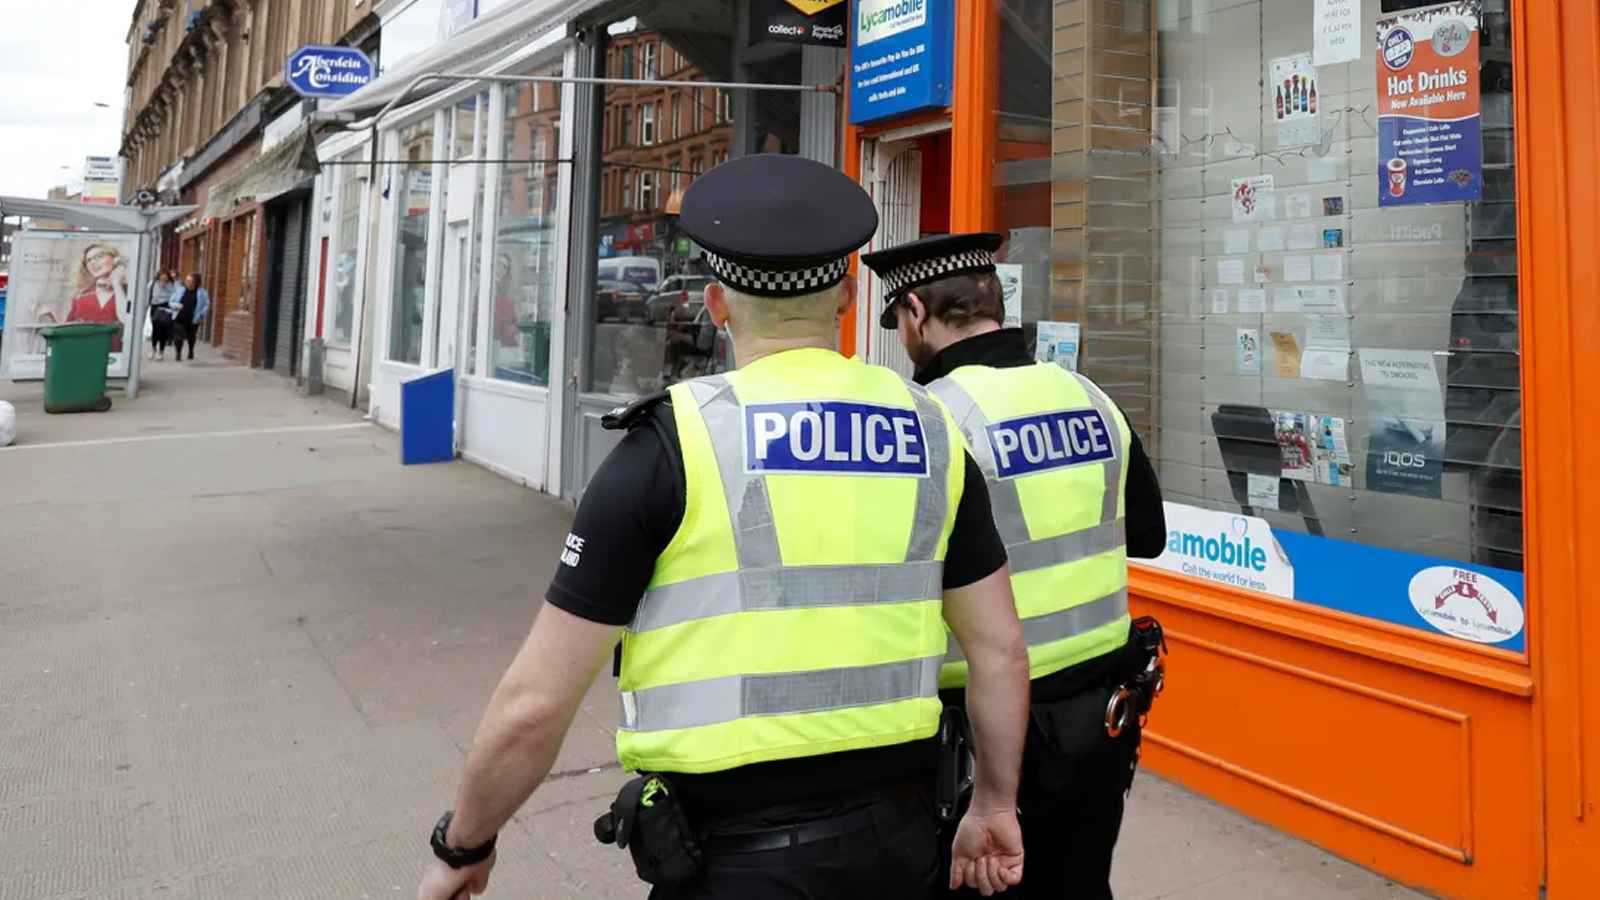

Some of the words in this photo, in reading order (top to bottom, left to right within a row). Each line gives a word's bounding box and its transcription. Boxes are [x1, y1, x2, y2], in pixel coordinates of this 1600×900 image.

[861, 0, 923, 33] Lycamobile
[292, 55, 361, 78] Aberdein
[309, 66, 369, 88] Considine
[1387, 74, 1414, 97] Hot
[1418, 66, 1468, 92] Drinks
[1391, 98, 1408, 110] Now
[1409, 91, 1446, 107] Available
[1446, 90, 1467, 102] Here
[752, 410, 922, 465] POLICE
[992, 414, 1109, 470] POLICE
[1383, 450, 1426, 468] IQOS
[1167, 530, 1267, 572] amobile
[1182, 562, 1198, 573] Call
[1199, 567, 1211, 577] the
[1212, 571, 1236, 584] world
[1236, 575, 1248, 586] for
[1248, 577, 1267, 590] less
[1453, 569, 1478, 583] FREE
